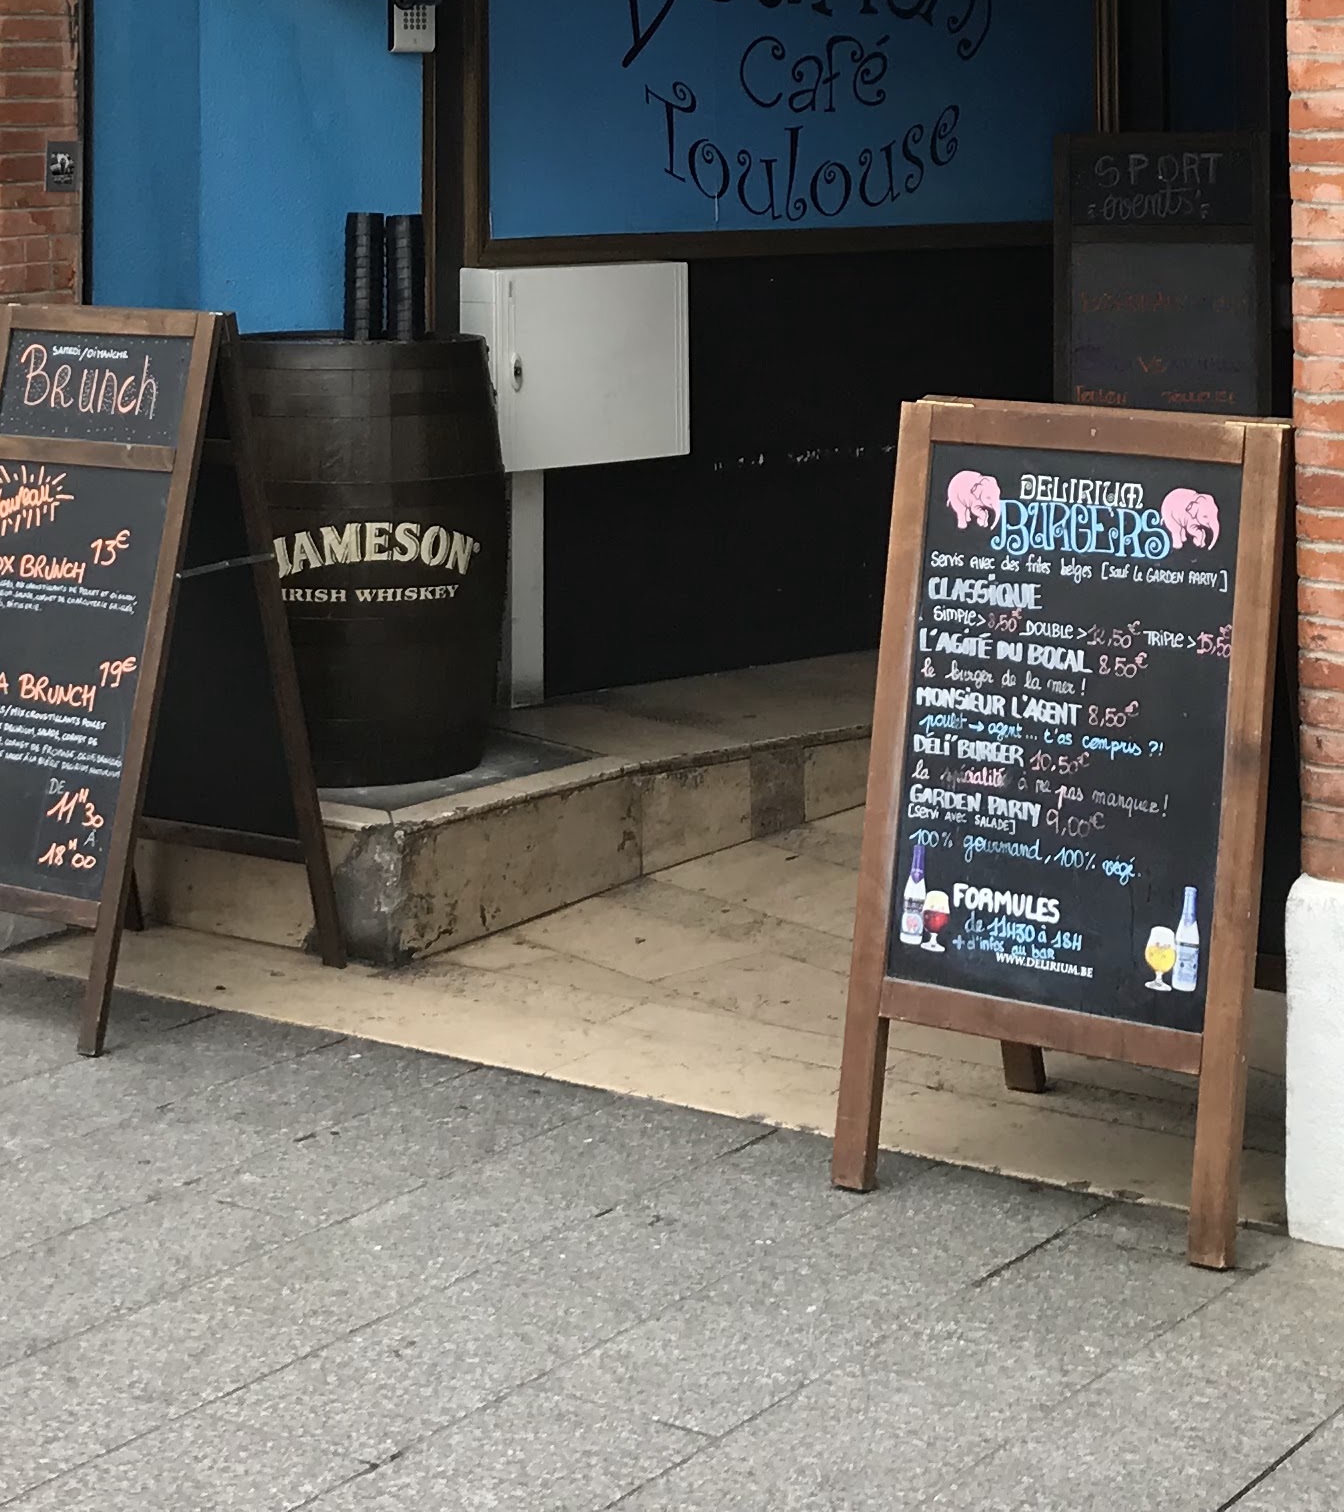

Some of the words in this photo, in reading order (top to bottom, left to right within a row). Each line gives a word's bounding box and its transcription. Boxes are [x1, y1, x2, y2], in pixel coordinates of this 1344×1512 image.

[739, 33, 891, 115] Café
[644, 80, 961, 222] Toulouse
[1094, 152, 1223, 188] SPORT
[1019, 473, 1143, 509] DELIRIUM
[990, 499, 1171, 560] BURGERS
[273, 521, 474, 578] JAMESON
[20, 554, 86, 584] BRUNCH
[1001, 555, 1020, 571] des
[1026, 554, 1051, 574] frites
[1060, 556, 1092, 583] belges
[1146, 568, 1184, 584] GARDEN
[281, 587, 347, 603] IRISH
[355, 584, 459, 603] WHISKEY
[921, 657, 936, 678] le
[945, 659, 994, 688] burger
[1001, 668, 1017, 688] de
[1024, 670, 1042, 690] la
[1047, 678, 1075, 694] mer
[996, 642, 1023, 662] DU
[1027, 643, 1093, 674] BOCAL
[19, 673, 97, 713] BRUNCH
[1011, 694, 1083, 726] L'AGENT
[919, 713, 967, 734] poulet
[1082, 735, 1142, 760] compris
[957, 738, 1024, 767] BURGER
[48, 777, 66, 794] DE
[912, 759, 930, 779] la
[1035, 778, 1051, 794] ne
[1055, 785, 1084, 810] pas
[910, 783, 981, 812] GARDEN
[988, 795, 1041, 827] PARTY
[953, 883, 1060, 924] FORMULES
[965, 910, 986, 933] de
[1051, 930, 1083, 952] 18H
[968, 935, 1004, 954] d'infos
[1011, 944, 1027, 959] au
[1031, 944, 1055, 960] bar
[996, 952, 1094, 978] WWW.DELIRIUM.BE
